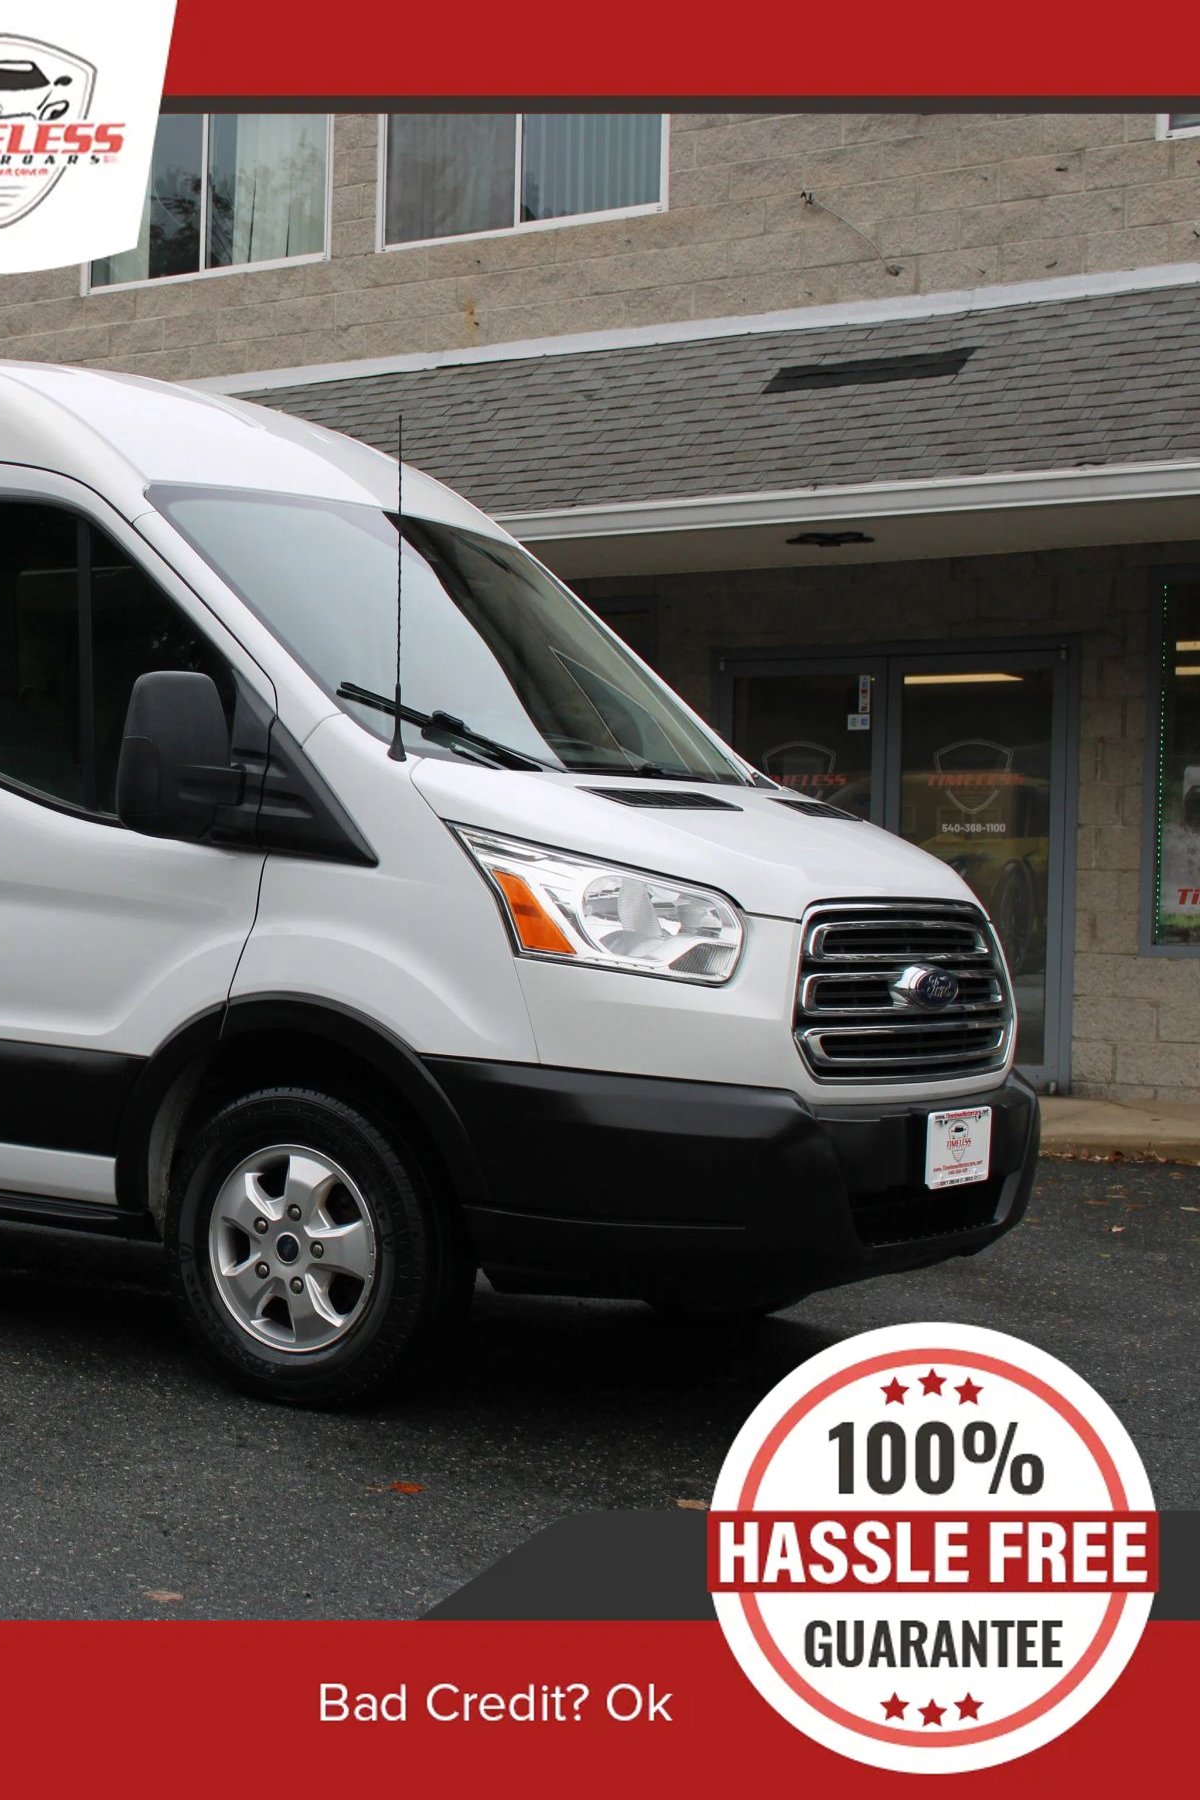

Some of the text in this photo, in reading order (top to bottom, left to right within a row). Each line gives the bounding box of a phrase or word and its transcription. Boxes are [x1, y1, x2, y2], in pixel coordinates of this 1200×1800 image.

[927, 773, 1026, 786] TIMELESS
[942, 823, 1006, 833] 540-368-1100
[927, 975, 953, 999] Ford
[947, 1138, 972, 1149] TIMELESS
